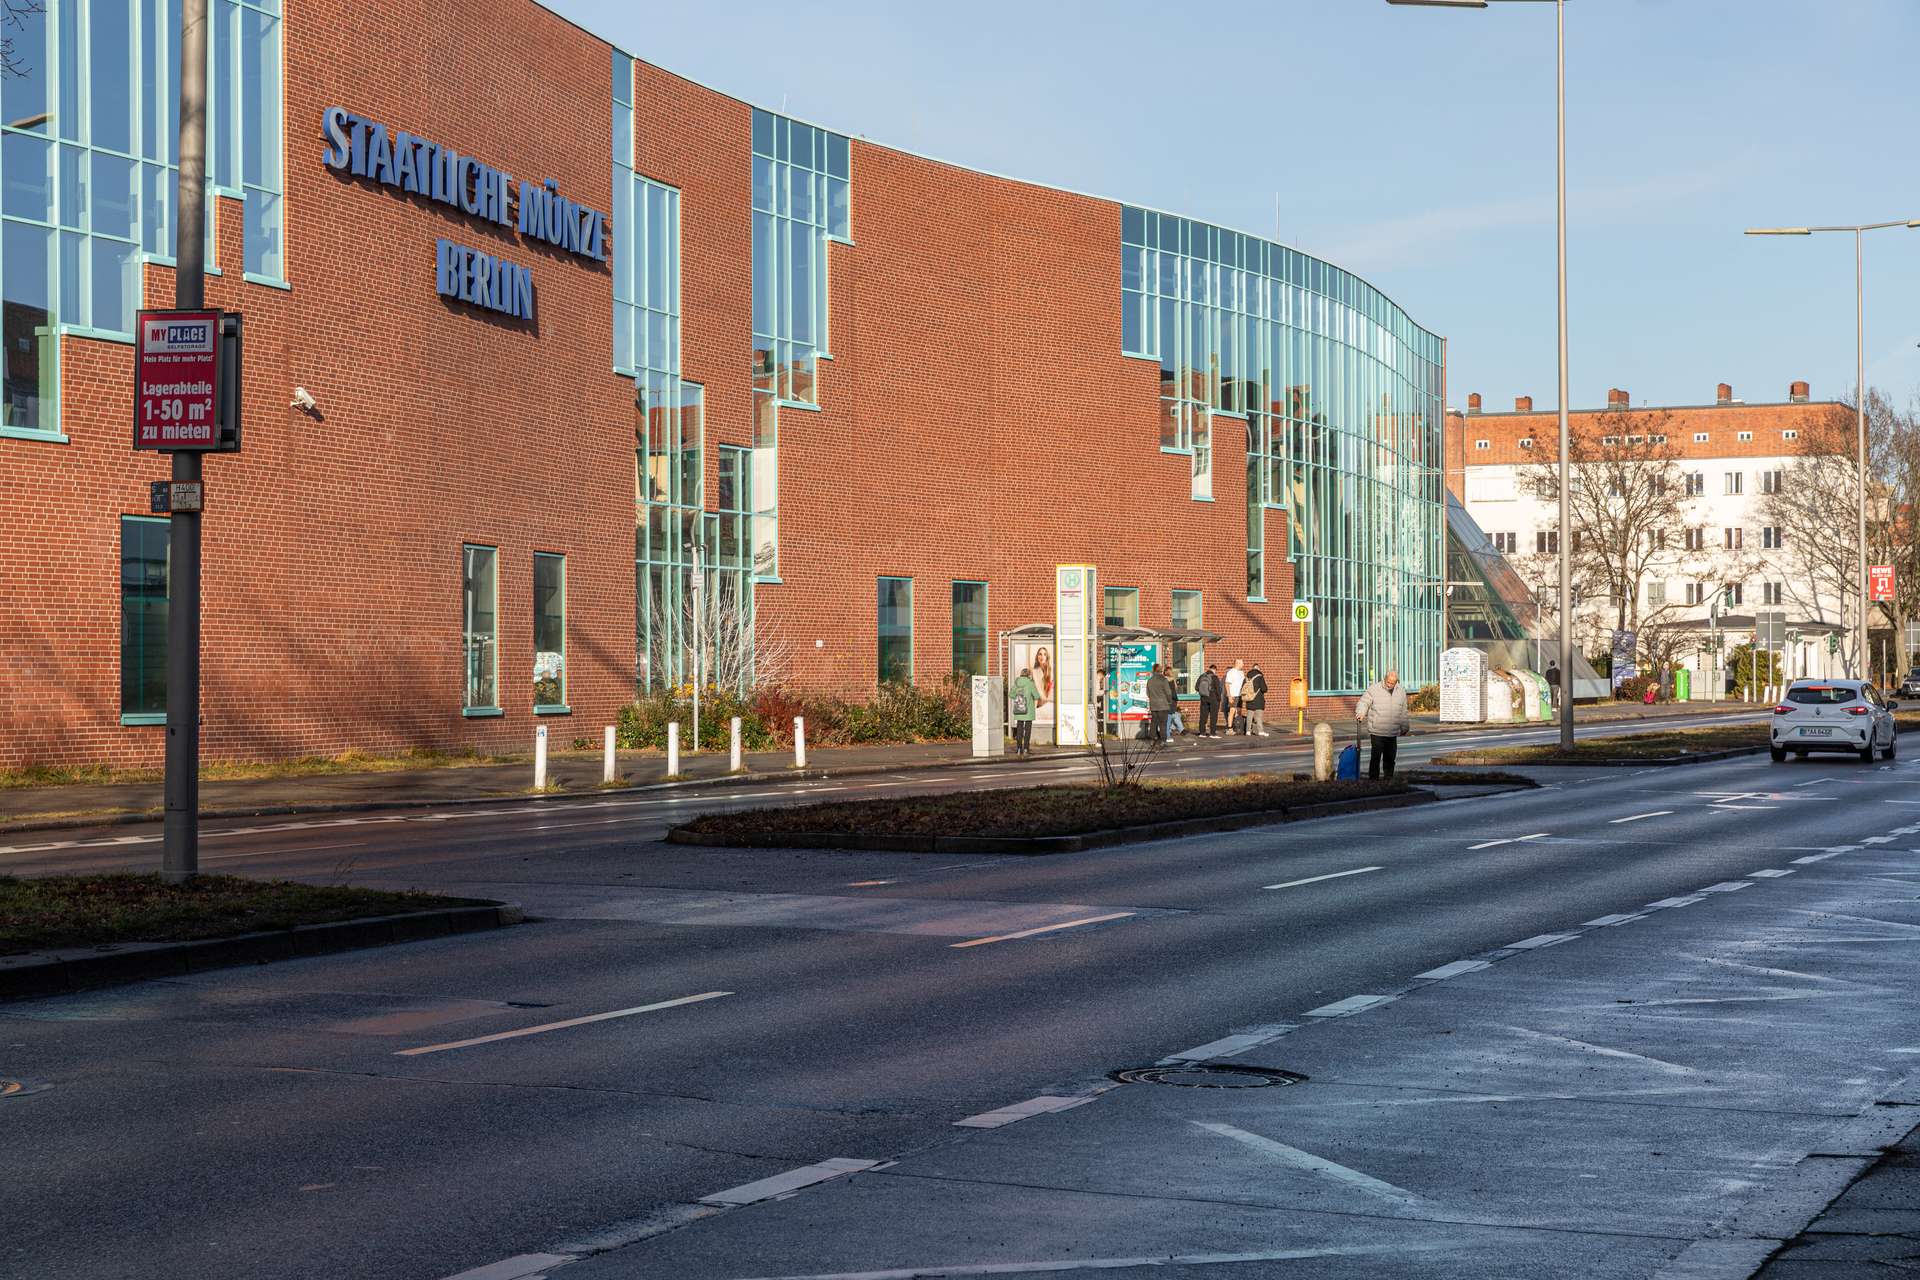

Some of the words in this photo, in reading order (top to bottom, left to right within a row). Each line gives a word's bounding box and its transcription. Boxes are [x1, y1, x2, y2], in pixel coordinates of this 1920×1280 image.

[322, 105, 513, 227] STAATLICHE
[518, 177, 608, 262] MÜNZE
[436, 239, 533, 320] BERLIN
[151, 328, 167, 342] MY
[169, 327, 205, 342] PLACE
[143, 381, 212, 396] Lagerabteile
[143, 399, 183, 420] 1-50
[188, 398, 212, 420] m²
[142, 425, 158, 439] zu
[162, 422, 211, 439] mieten
